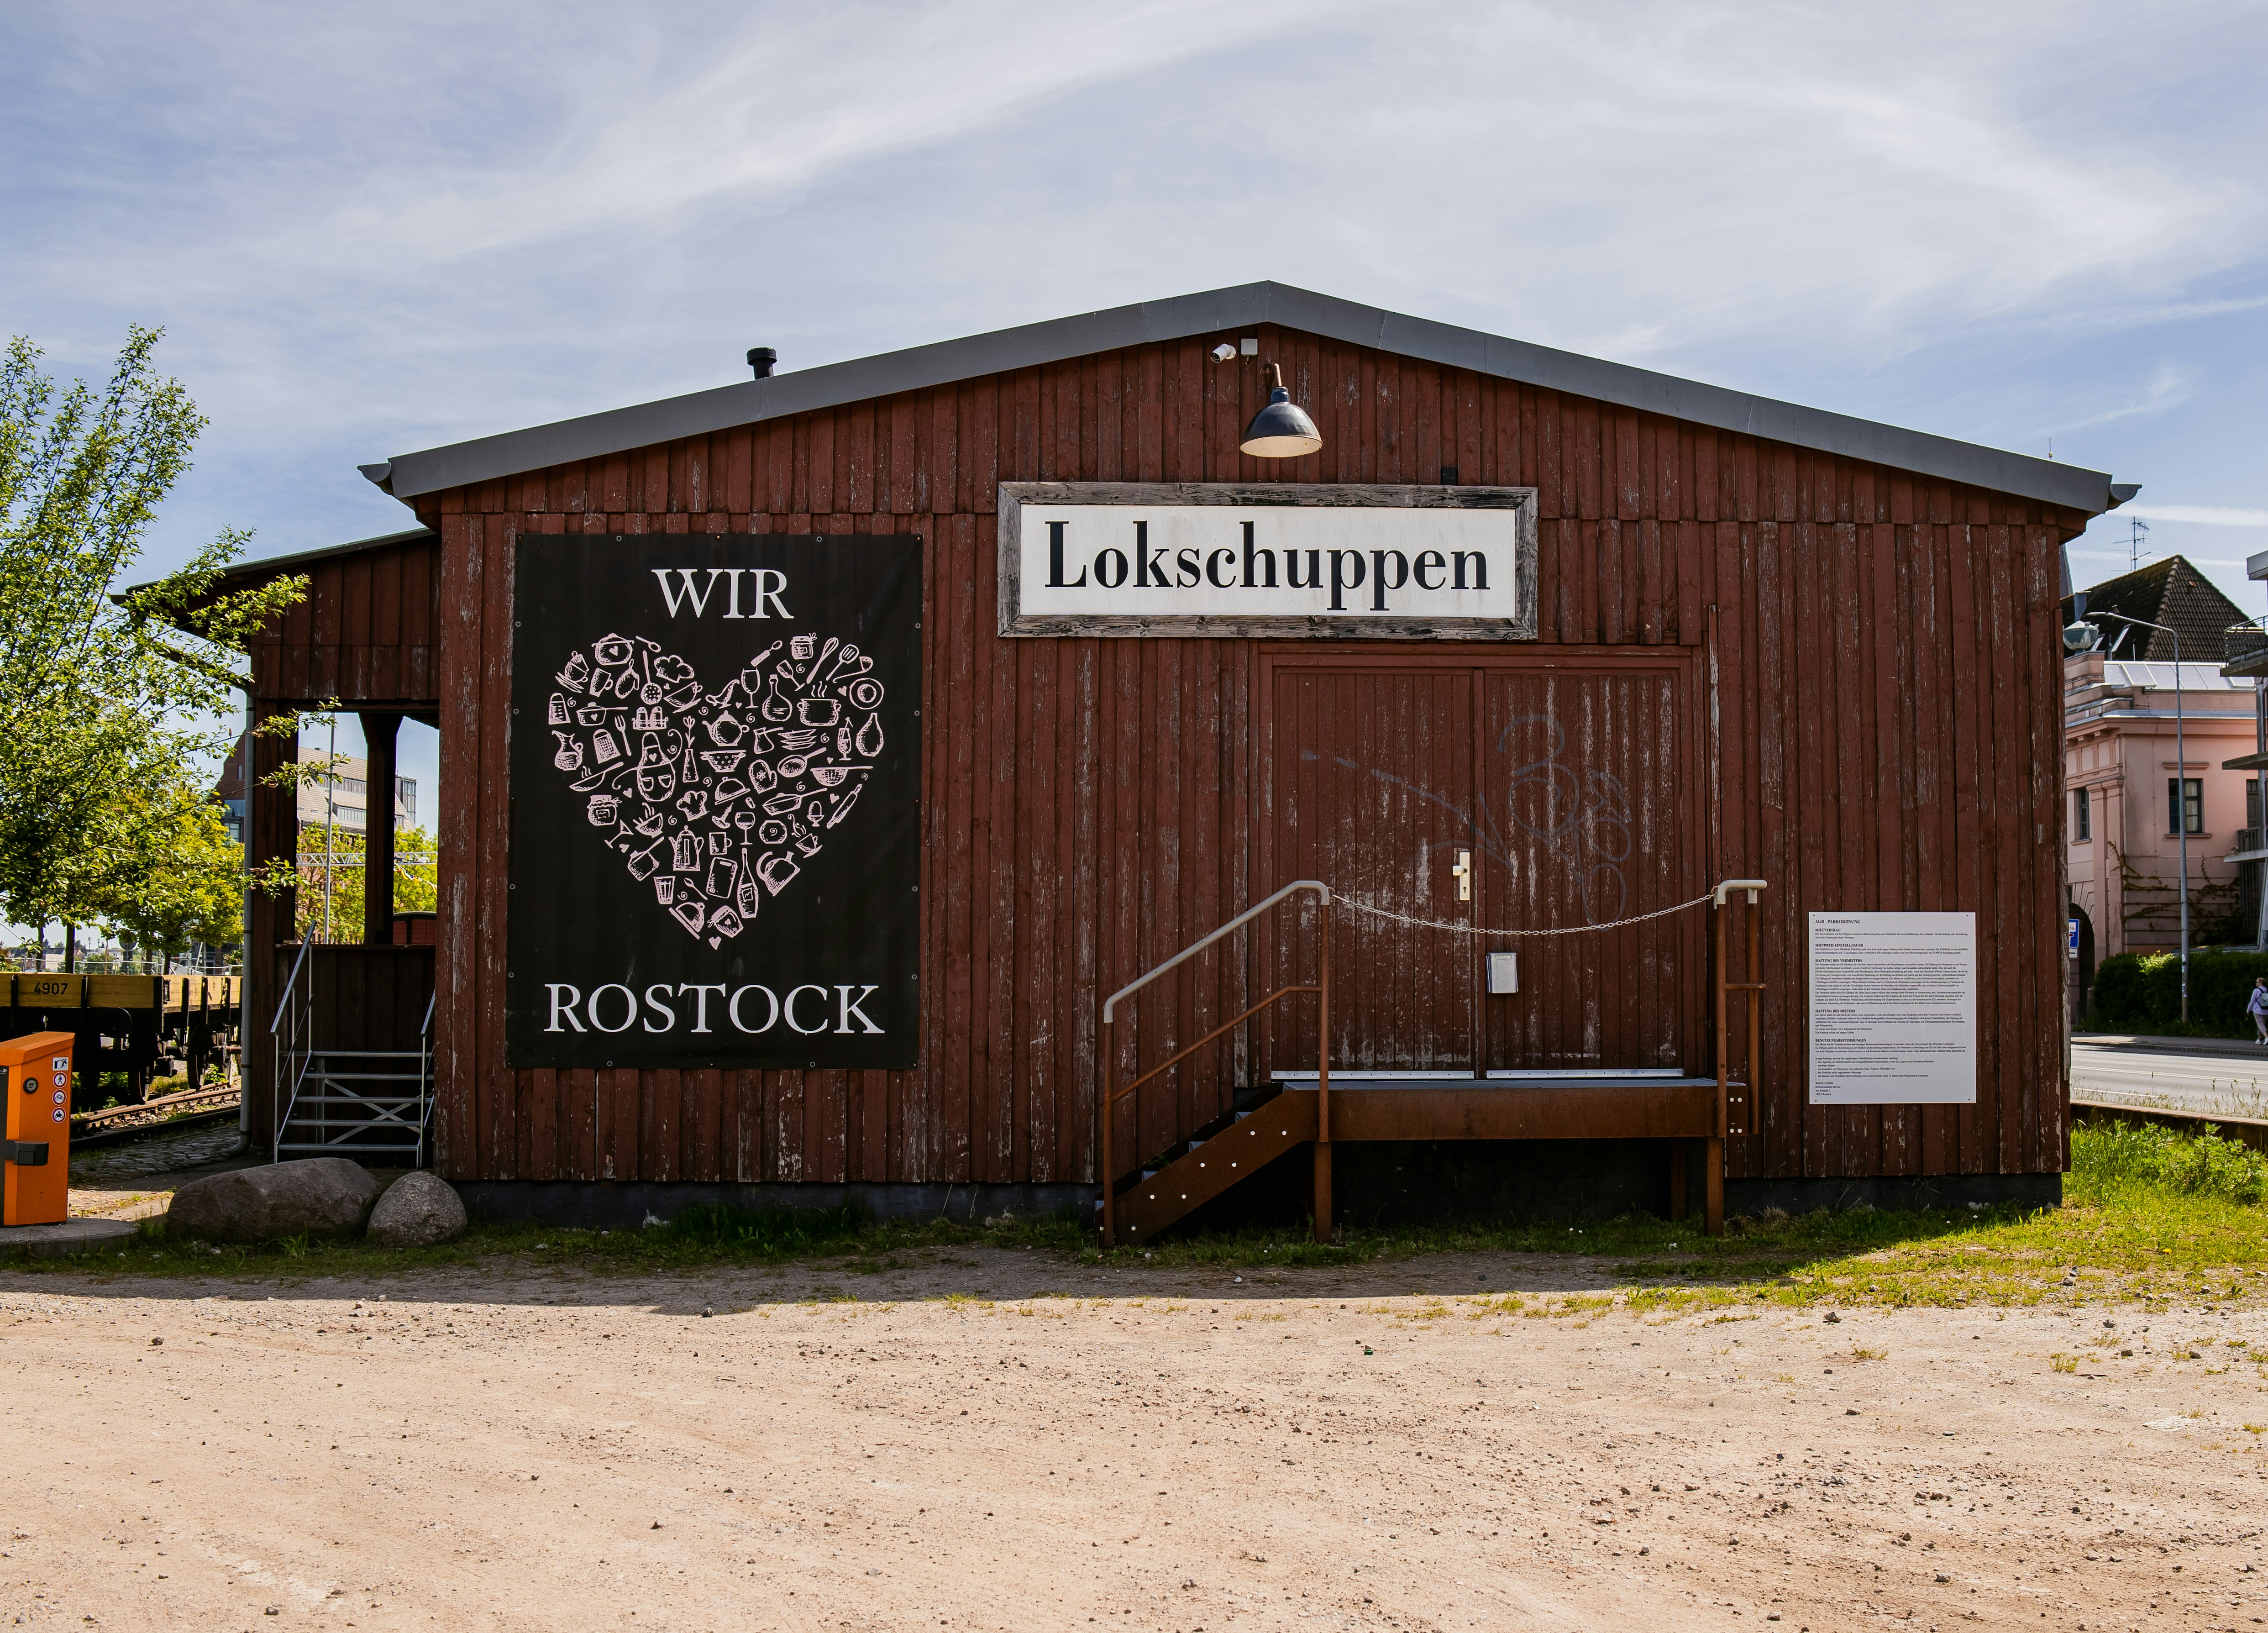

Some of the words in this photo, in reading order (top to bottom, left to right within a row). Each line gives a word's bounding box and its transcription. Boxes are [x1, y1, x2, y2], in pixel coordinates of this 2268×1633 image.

[1045, 520, 1490, 610] Lokschuppen
[651, 569, 794, 619] WIR
[33, 982, 68, 995] 4907
[544, 983, 885, 1034] ROSTOCK
